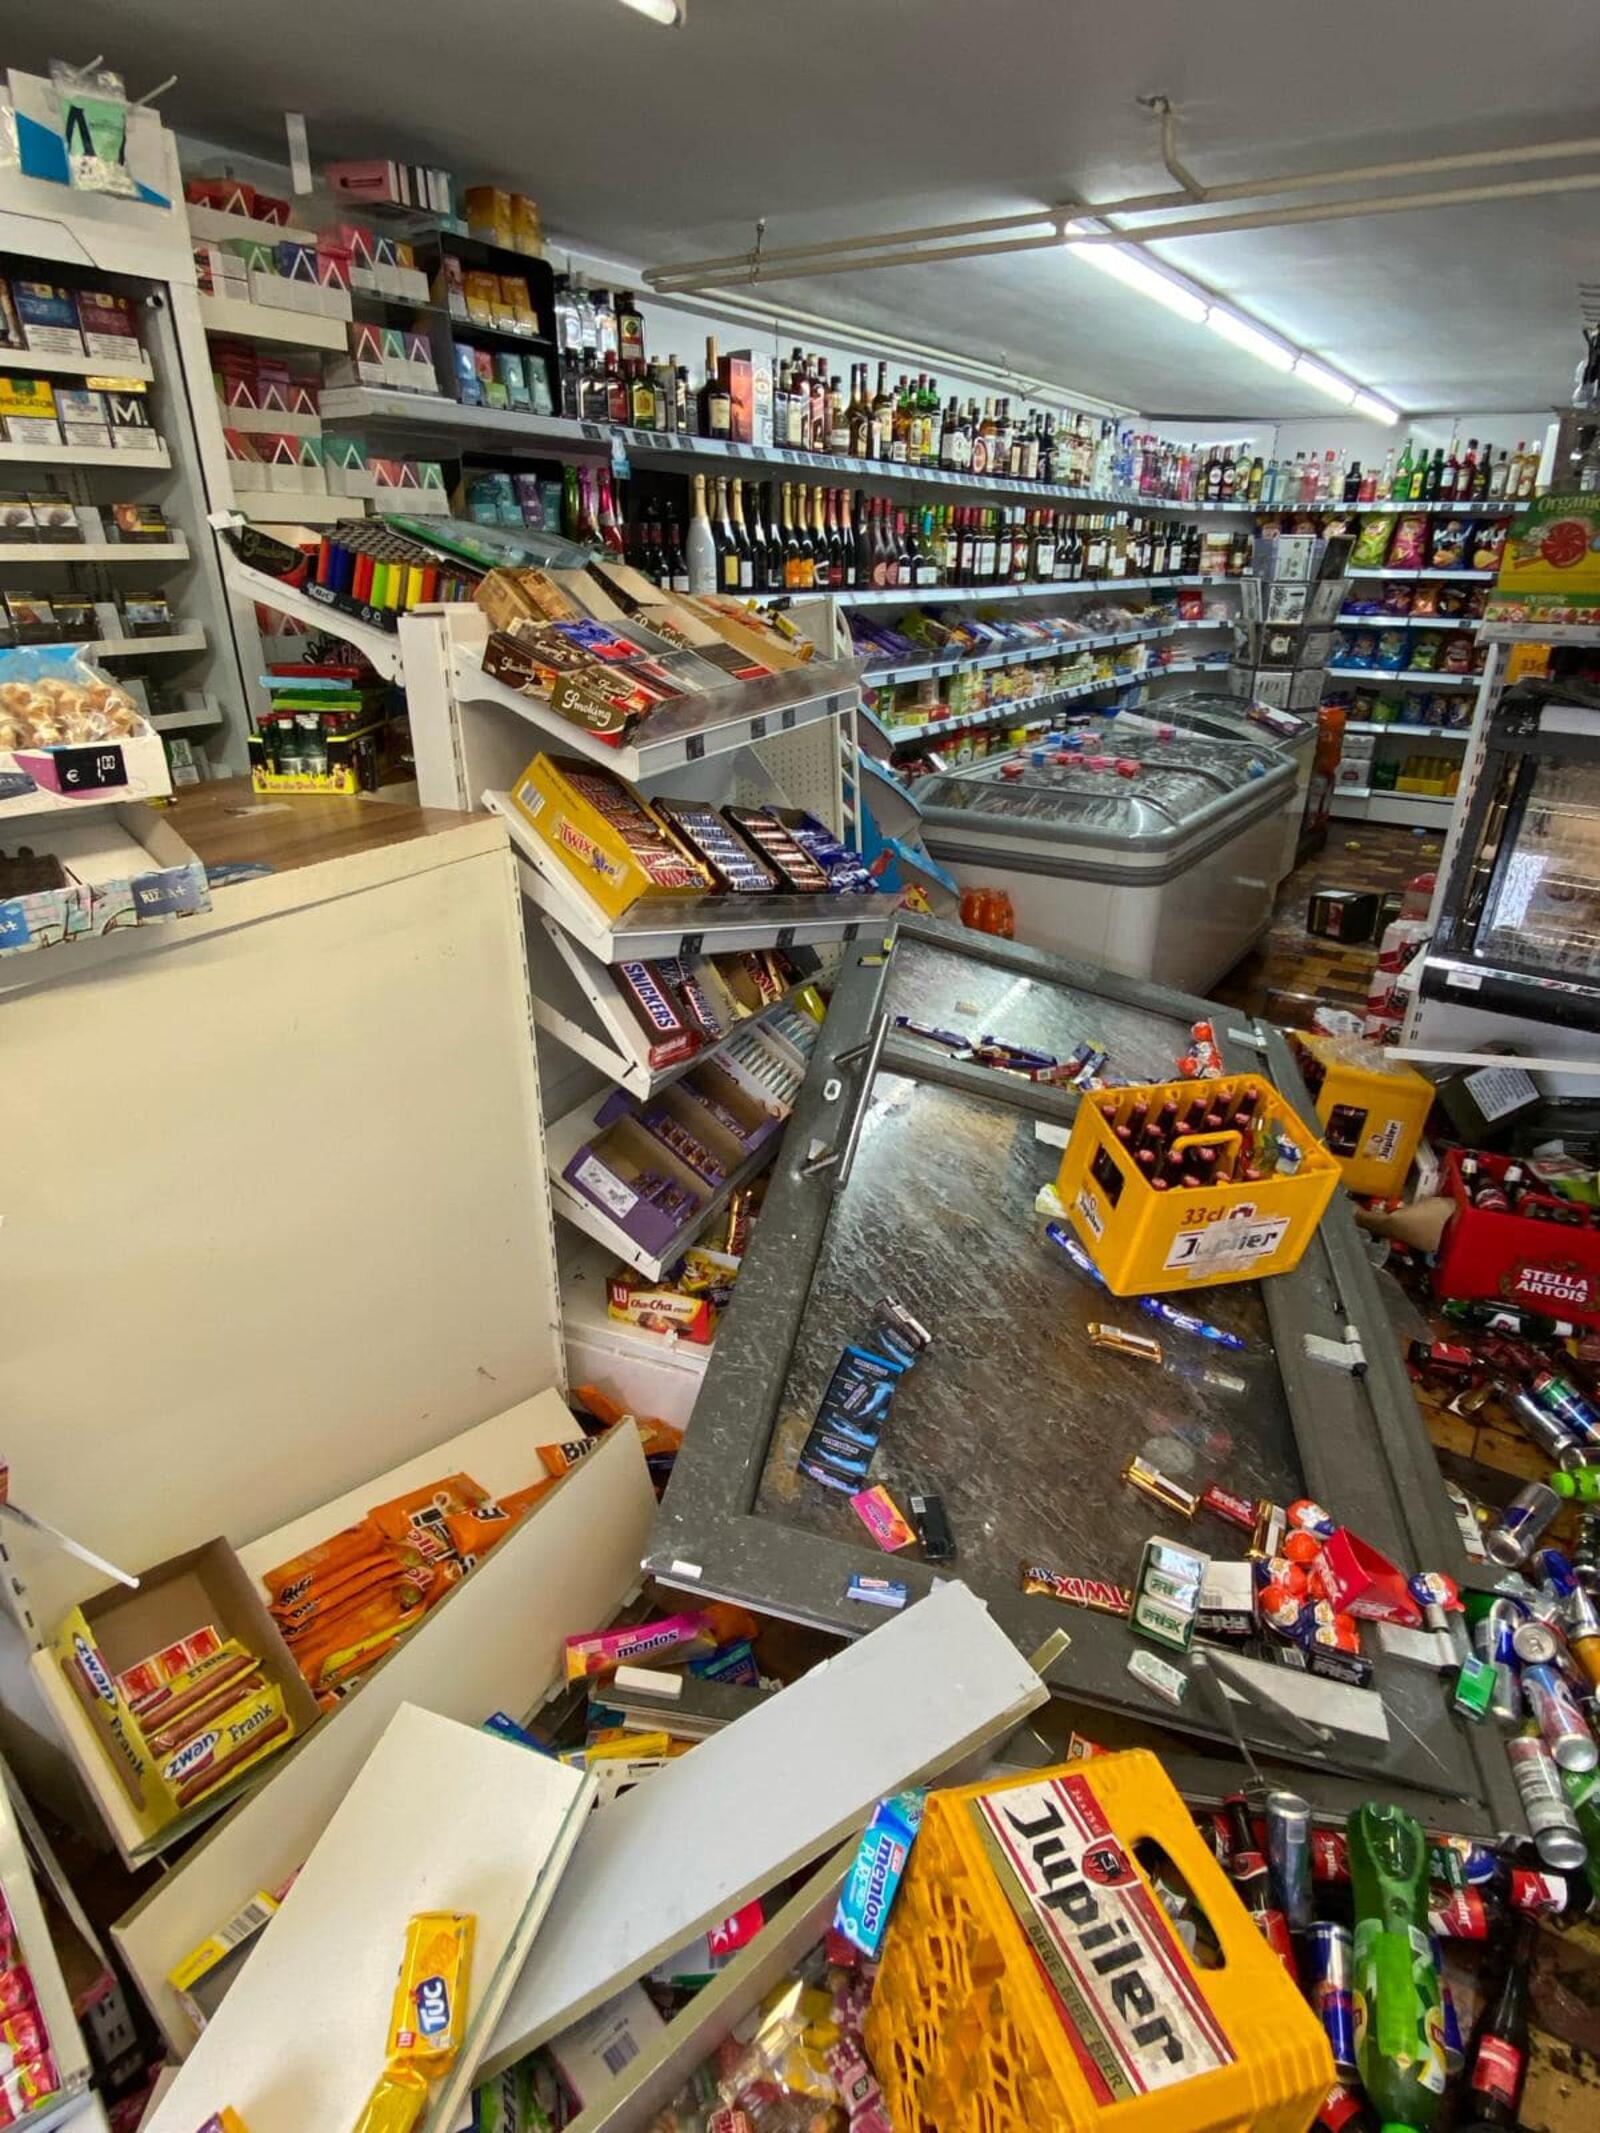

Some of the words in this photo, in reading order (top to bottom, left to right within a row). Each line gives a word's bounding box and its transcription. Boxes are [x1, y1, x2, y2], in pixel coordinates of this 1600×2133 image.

[561, 689, 612, 727] Smoking
[624, 961, 676, 1030] SNICKERS
[1514, 1279, 1588, 1303] ARTOIS
[1519, 1268, 1590, 1292] STELLA
[615, 1628, 680, 1659] mentos
[1142, 1607, 1183, 1635] FRISK
[77, 1642, 118, 1704] zwan
[109, 1715, 147, 1779] Frank
[167, 1731, 217, 1778] zwan
[225, 1702, 274, 1744] Frank
[863, 1832, 894, 1934] mentos
[1003, 1796, 1185, 2066] Jupiler
[419, 1980, 447, 2033] TUC
